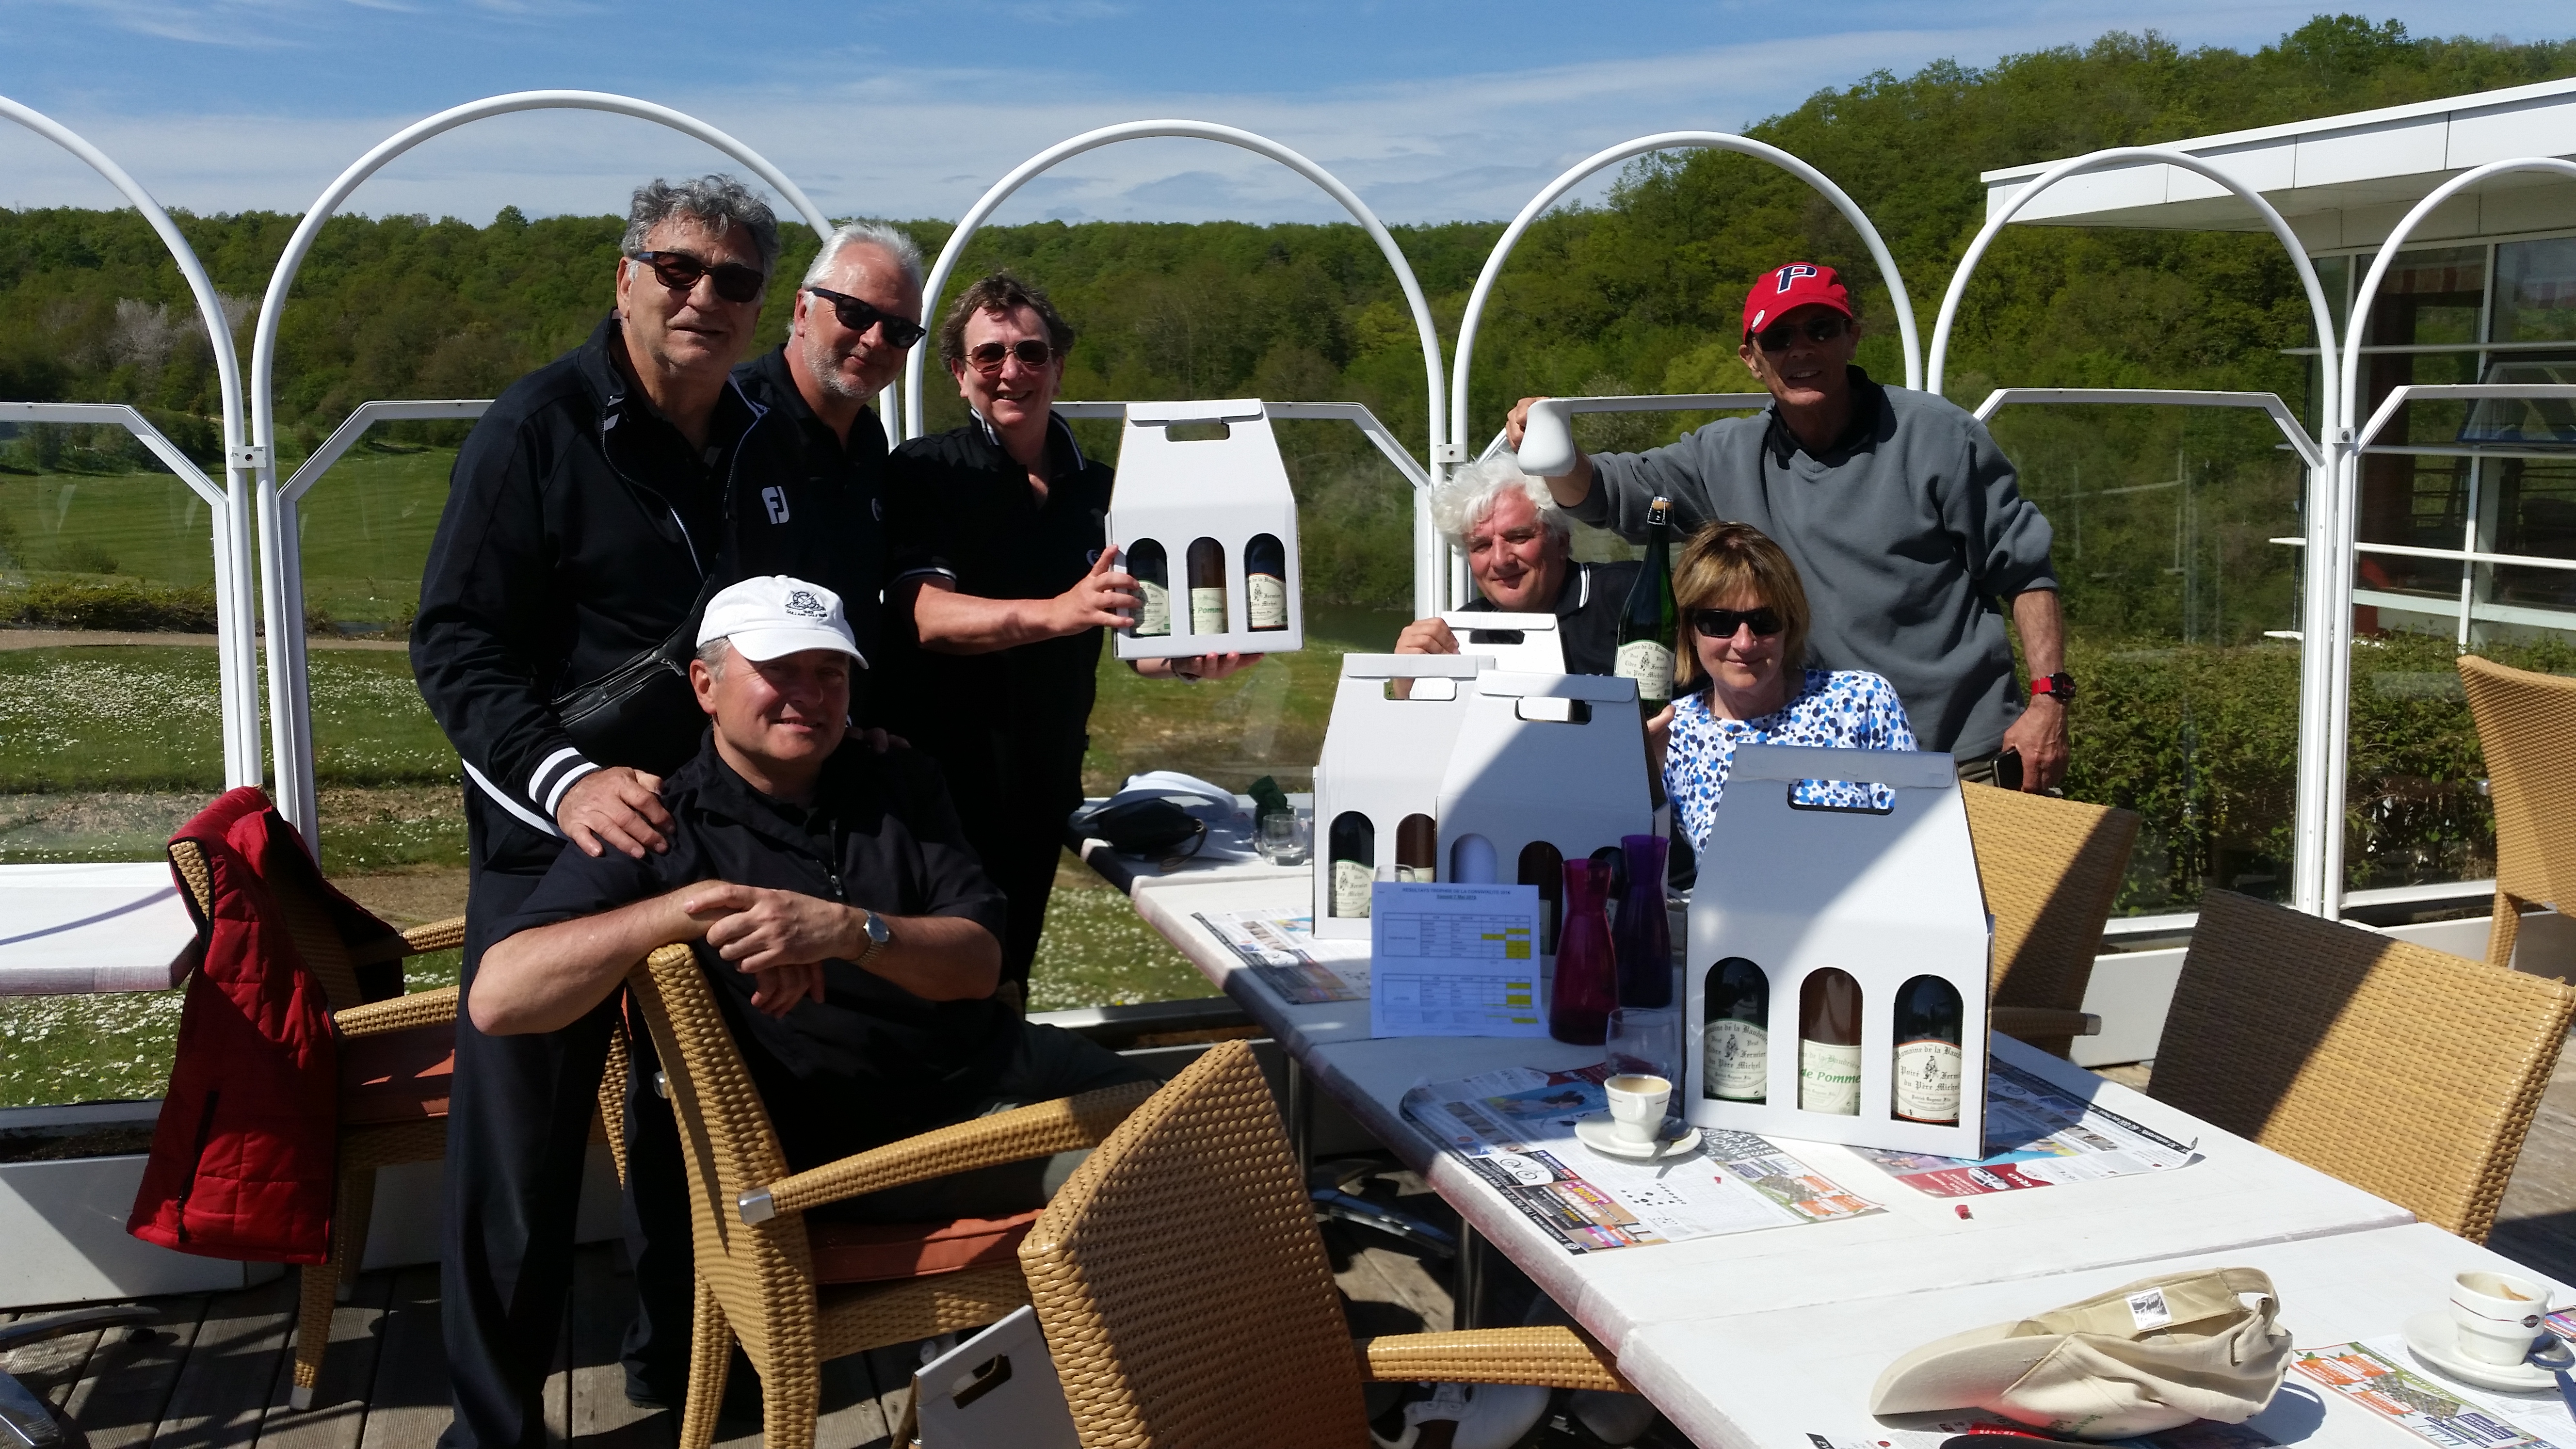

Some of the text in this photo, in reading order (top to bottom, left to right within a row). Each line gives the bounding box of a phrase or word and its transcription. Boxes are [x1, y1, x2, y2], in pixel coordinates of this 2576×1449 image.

[1776, 265, 1817, 294] P
[761, 486, 789, 524] FJ
[1893, 1046, 1922, 1062] Domaine
[1943, 1046, 1961, 1059] Baud
[1718, 1059, 1733, 1067] Père
[1736, 1062, 1760, 1070] Michel
[1901, 1065, 1919, 1077] Poiré
[1801, 1069, 1813, 1078] de
[1916, 1080, 1932, 1090] Père
[1935, 1083, 1960, 1091] Michel
[2007, 1173, 2033, 1187] RIO
[1572, 1188, 1599, 1202] BOIS
